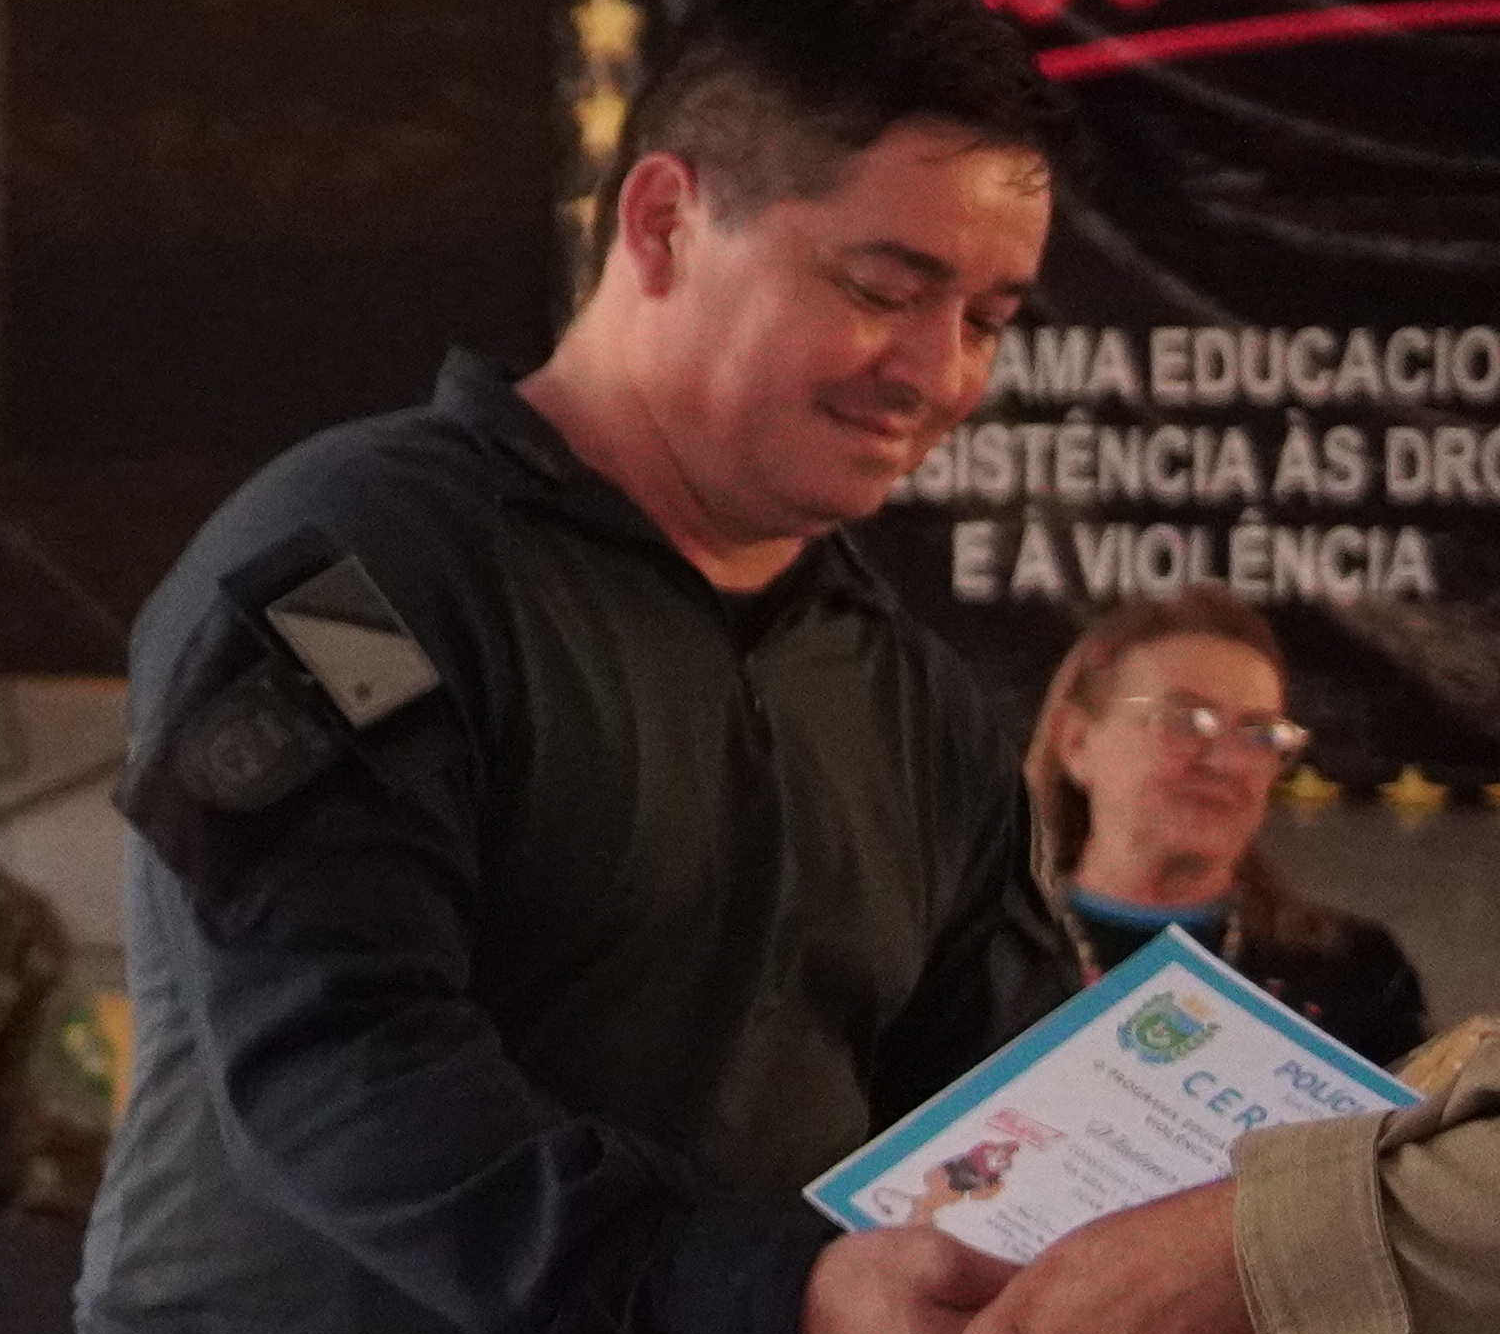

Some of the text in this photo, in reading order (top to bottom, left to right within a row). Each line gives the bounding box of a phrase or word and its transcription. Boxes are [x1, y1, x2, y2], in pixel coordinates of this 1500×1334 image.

[890, 408, 1258, 501] SISTÊNCIA
[953, 521, 996, 599] E
[1071, 507, 1437, 604] VIOLÊNCIA
[1181, 1069, 1276, 1130] CER
